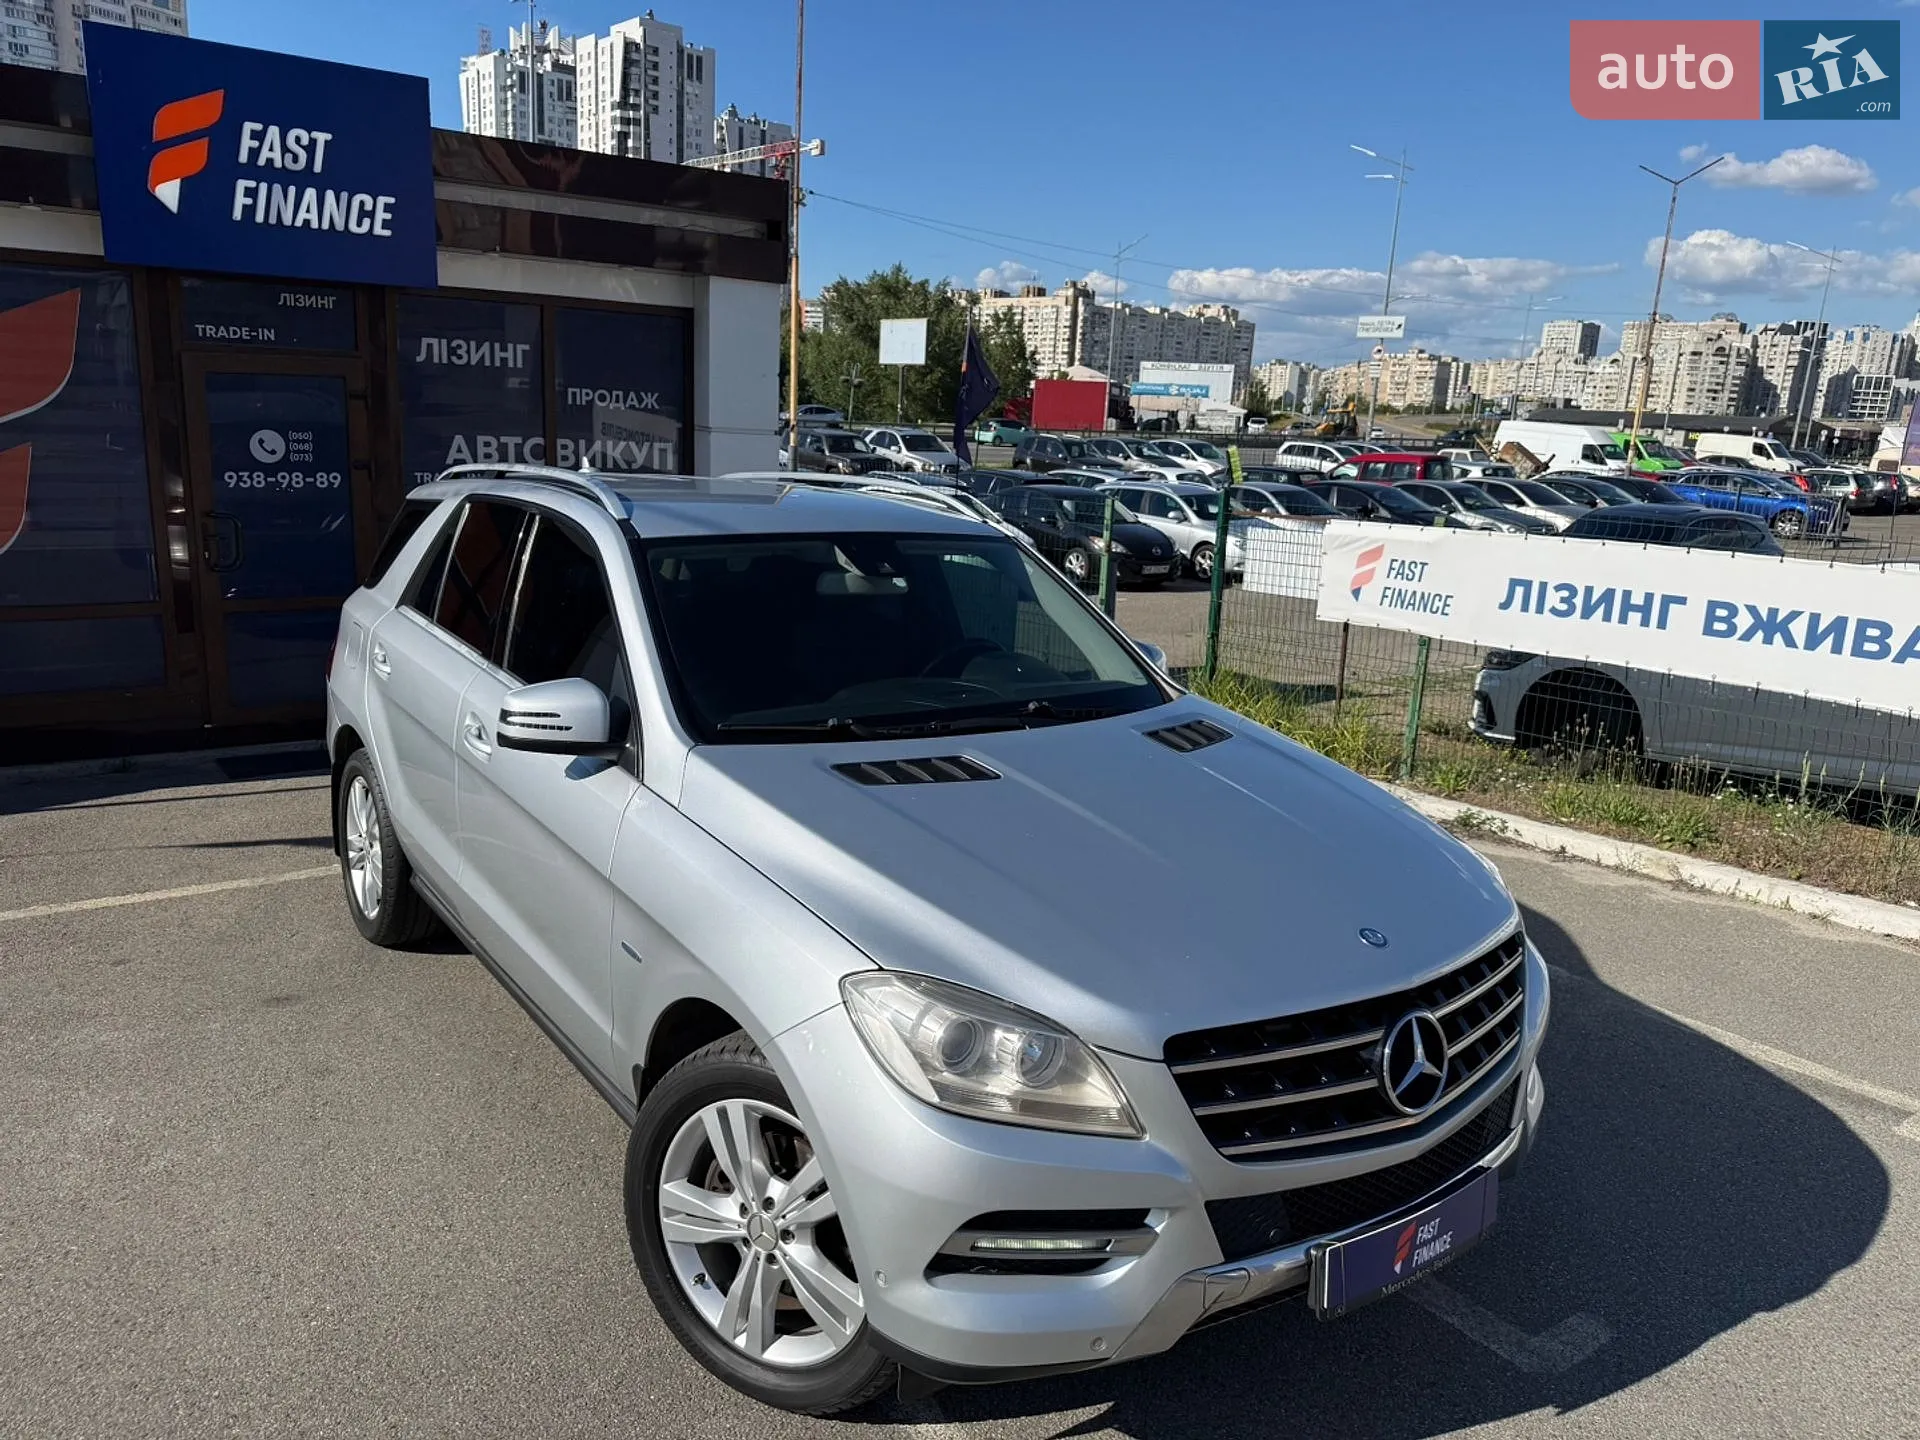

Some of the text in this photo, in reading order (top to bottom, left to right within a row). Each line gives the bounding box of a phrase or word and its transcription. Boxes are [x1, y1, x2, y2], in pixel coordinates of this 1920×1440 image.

[238, 121, 333, 173] FAST
[232, 178, 396, 237] FINANCE
[278, 293, 337, 309] ЛІЗИНГ
[195, 324, 276, 341] TRADE-IN
[416, 337, 530, 368] ЛІЗИНГ
[567, 387, 660, 410] ПРОДАЖ
[289, 441, 313, 451] (068)
[290, 452, 313, 462] (073)
[224, 472, 341, 488] 938-98-89
[1386, 558, 1429, 583] FAST
[1379, 586, 1454, 616] FINANCE
[1498, 577, 1687, 631] ЛІЗИНГ
[1416, 1217, 1441, 1245] FAST
[1412, 1230, 1453, 1267] FINANCE
